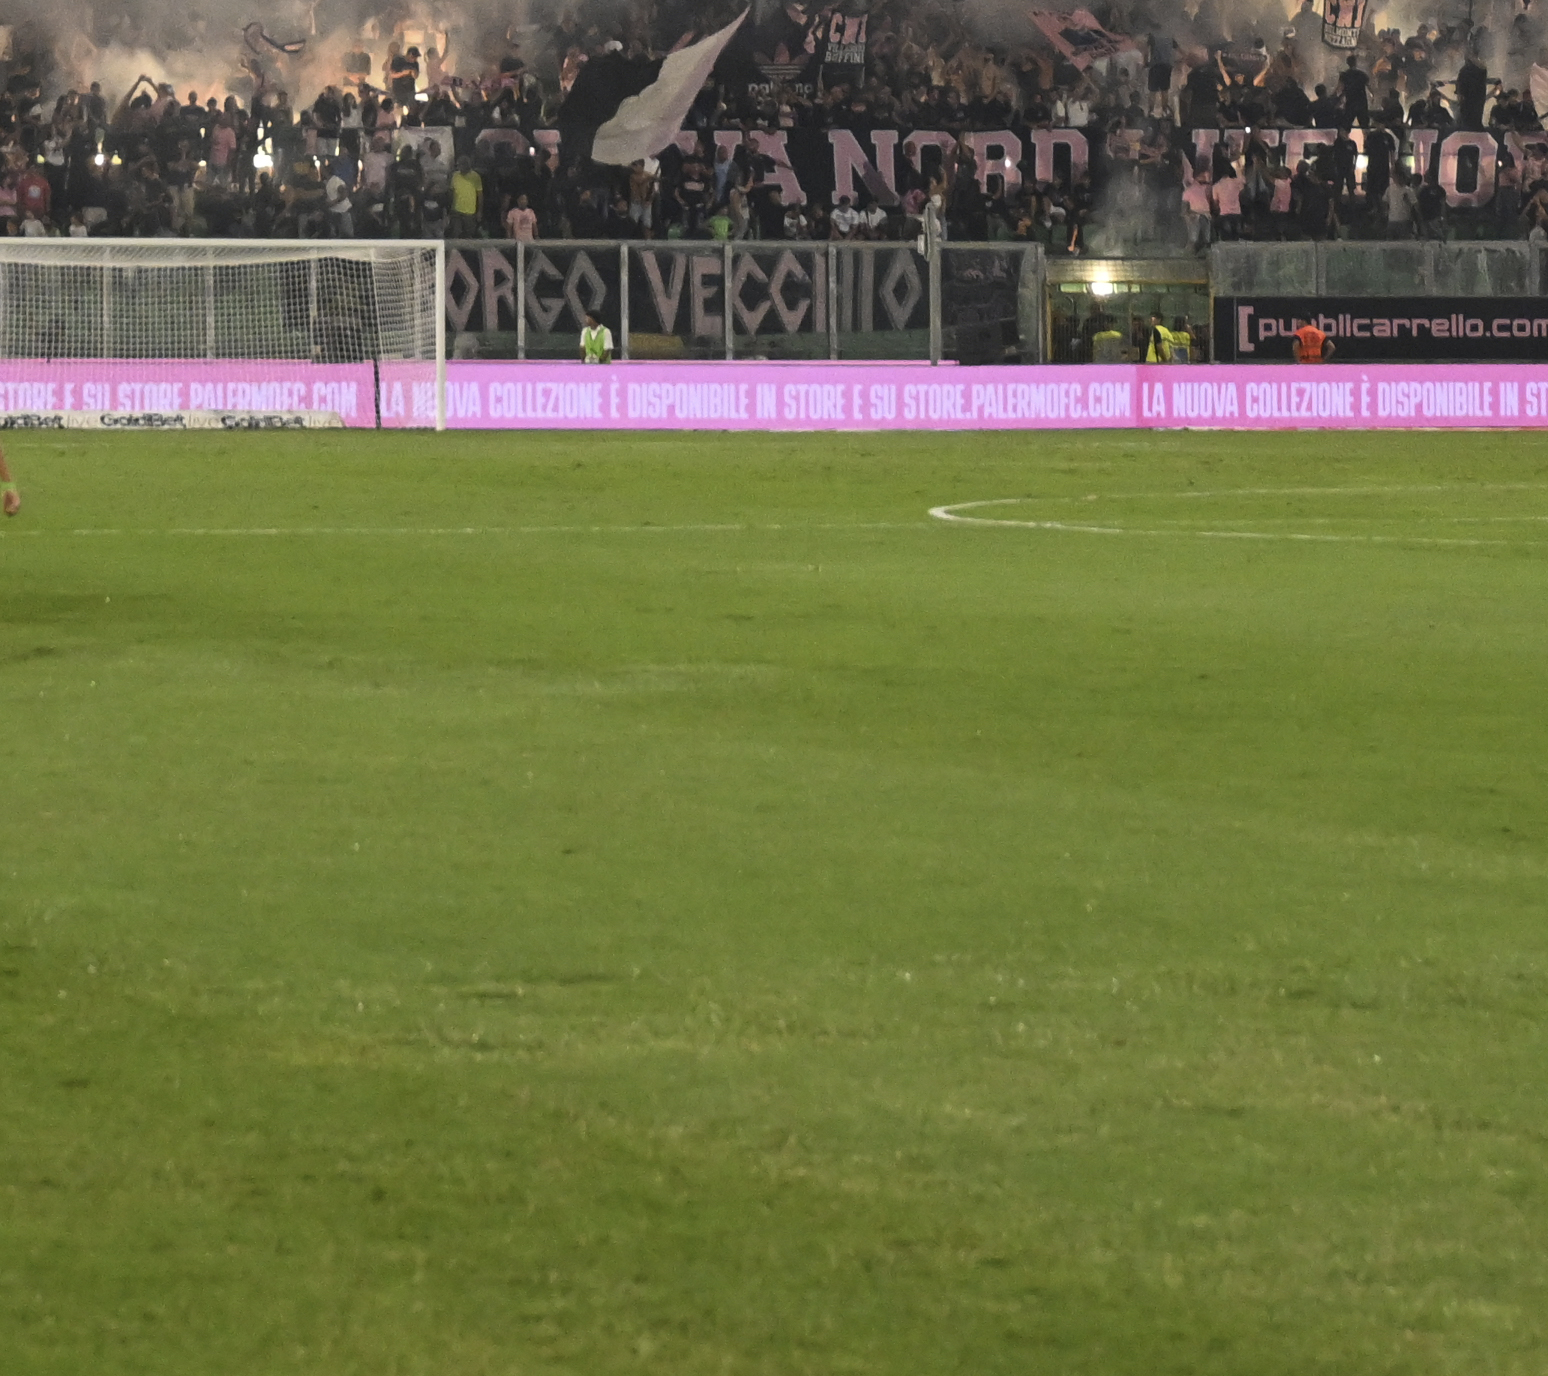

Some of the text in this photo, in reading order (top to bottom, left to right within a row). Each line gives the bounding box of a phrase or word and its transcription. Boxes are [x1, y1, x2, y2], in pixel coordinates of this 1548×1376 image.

[830, 128, 1090, 206] NORD
[445, 247, 607, 334] ORGO
[380, 373, 1132, 420] LA NUOVA COLLEZIONE È DISPONIBILE IN STORE E SU STORE.PALERMOFC.COM
[1142, 381, 1166, 417] LA
[1172, 381, 1239, 417] NUOVA
[1245, 381, 1355, 417] COLLEZIONE
[1360, 374, 1371, 417] È
[1377, 381, 1493, 417] DISPONIBILE
[1500, 381, 1520, 417] IN
[100, 413, 185, 429] GoldBet
